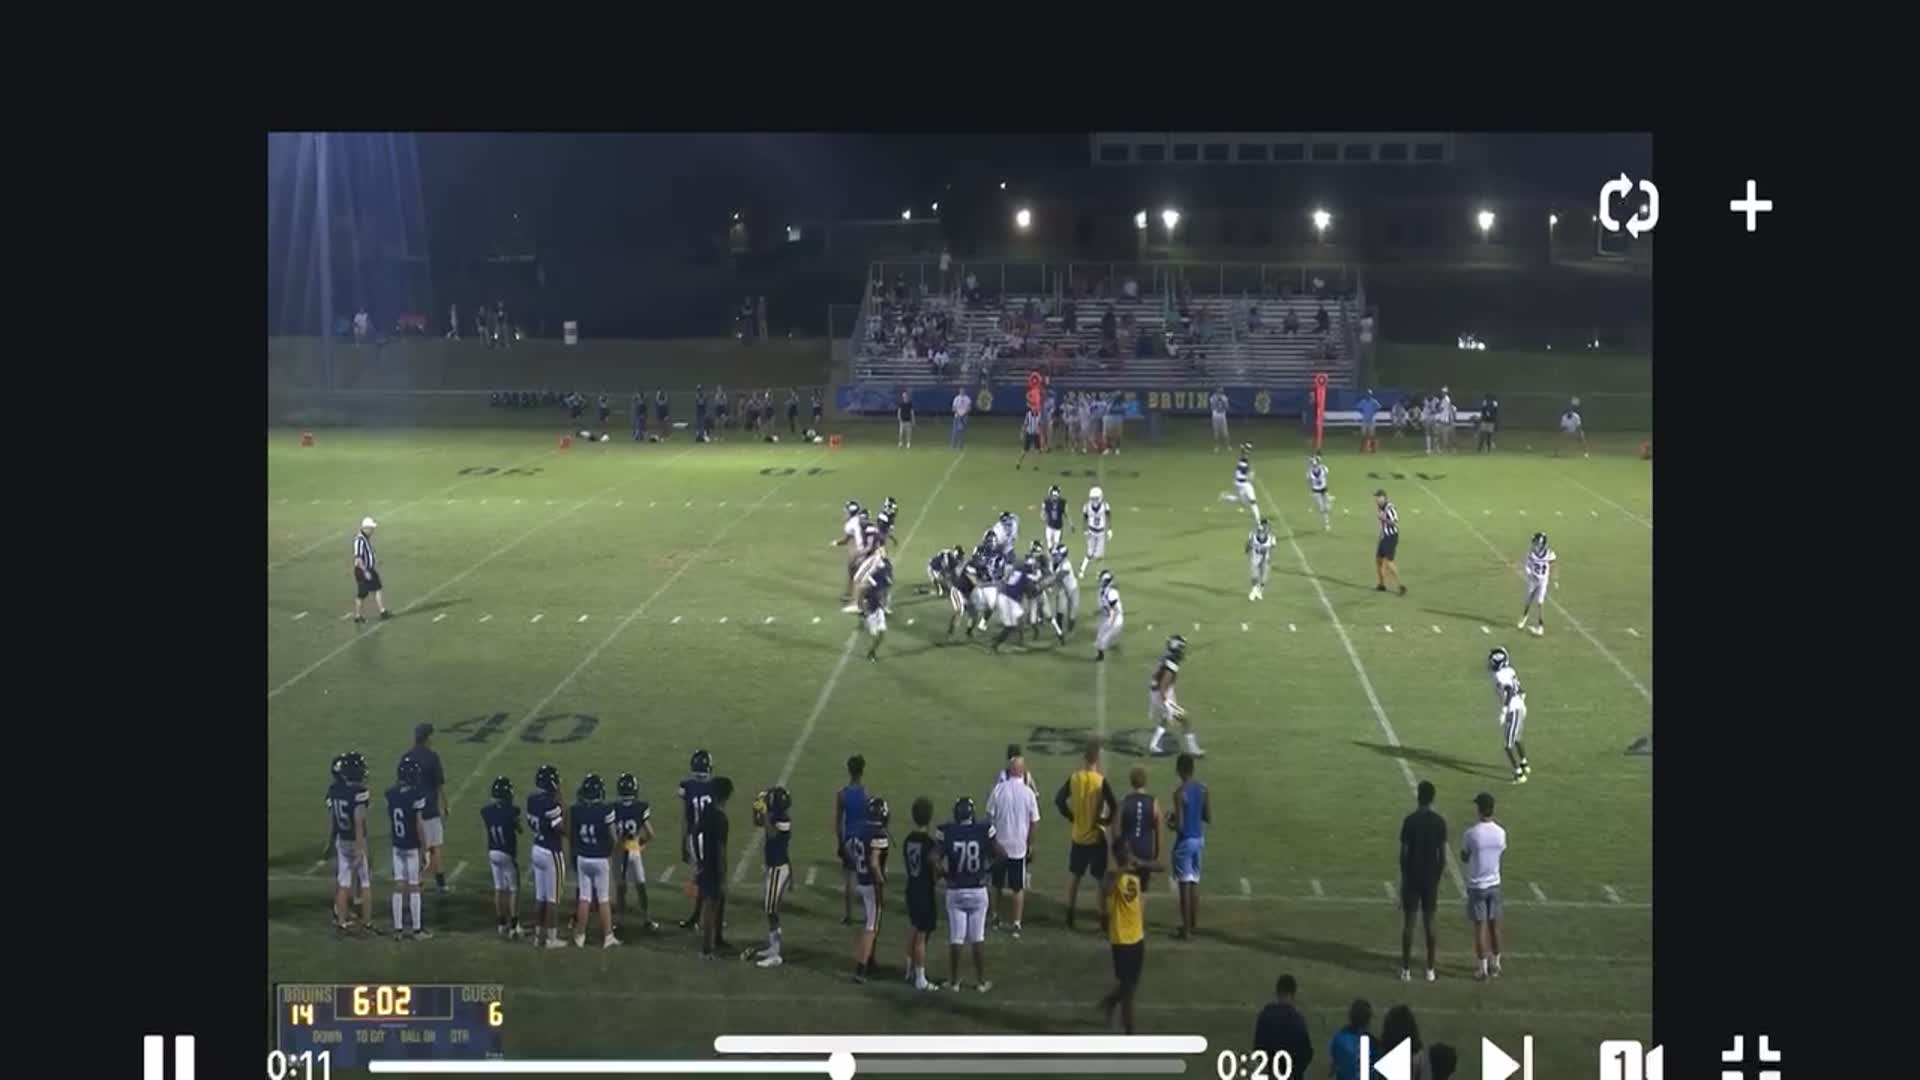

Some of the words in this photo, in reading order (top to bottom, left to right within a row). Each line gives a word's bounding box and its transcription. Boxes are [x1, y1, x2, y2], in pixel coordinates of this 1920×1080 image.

[439, 712, 599, 744] 40
[1026, 725, 1182, 758] 50
[334, 798, 351, 831] 15
[393, 807, 405, 837] 6
[952, 840, 981, 873] 78
